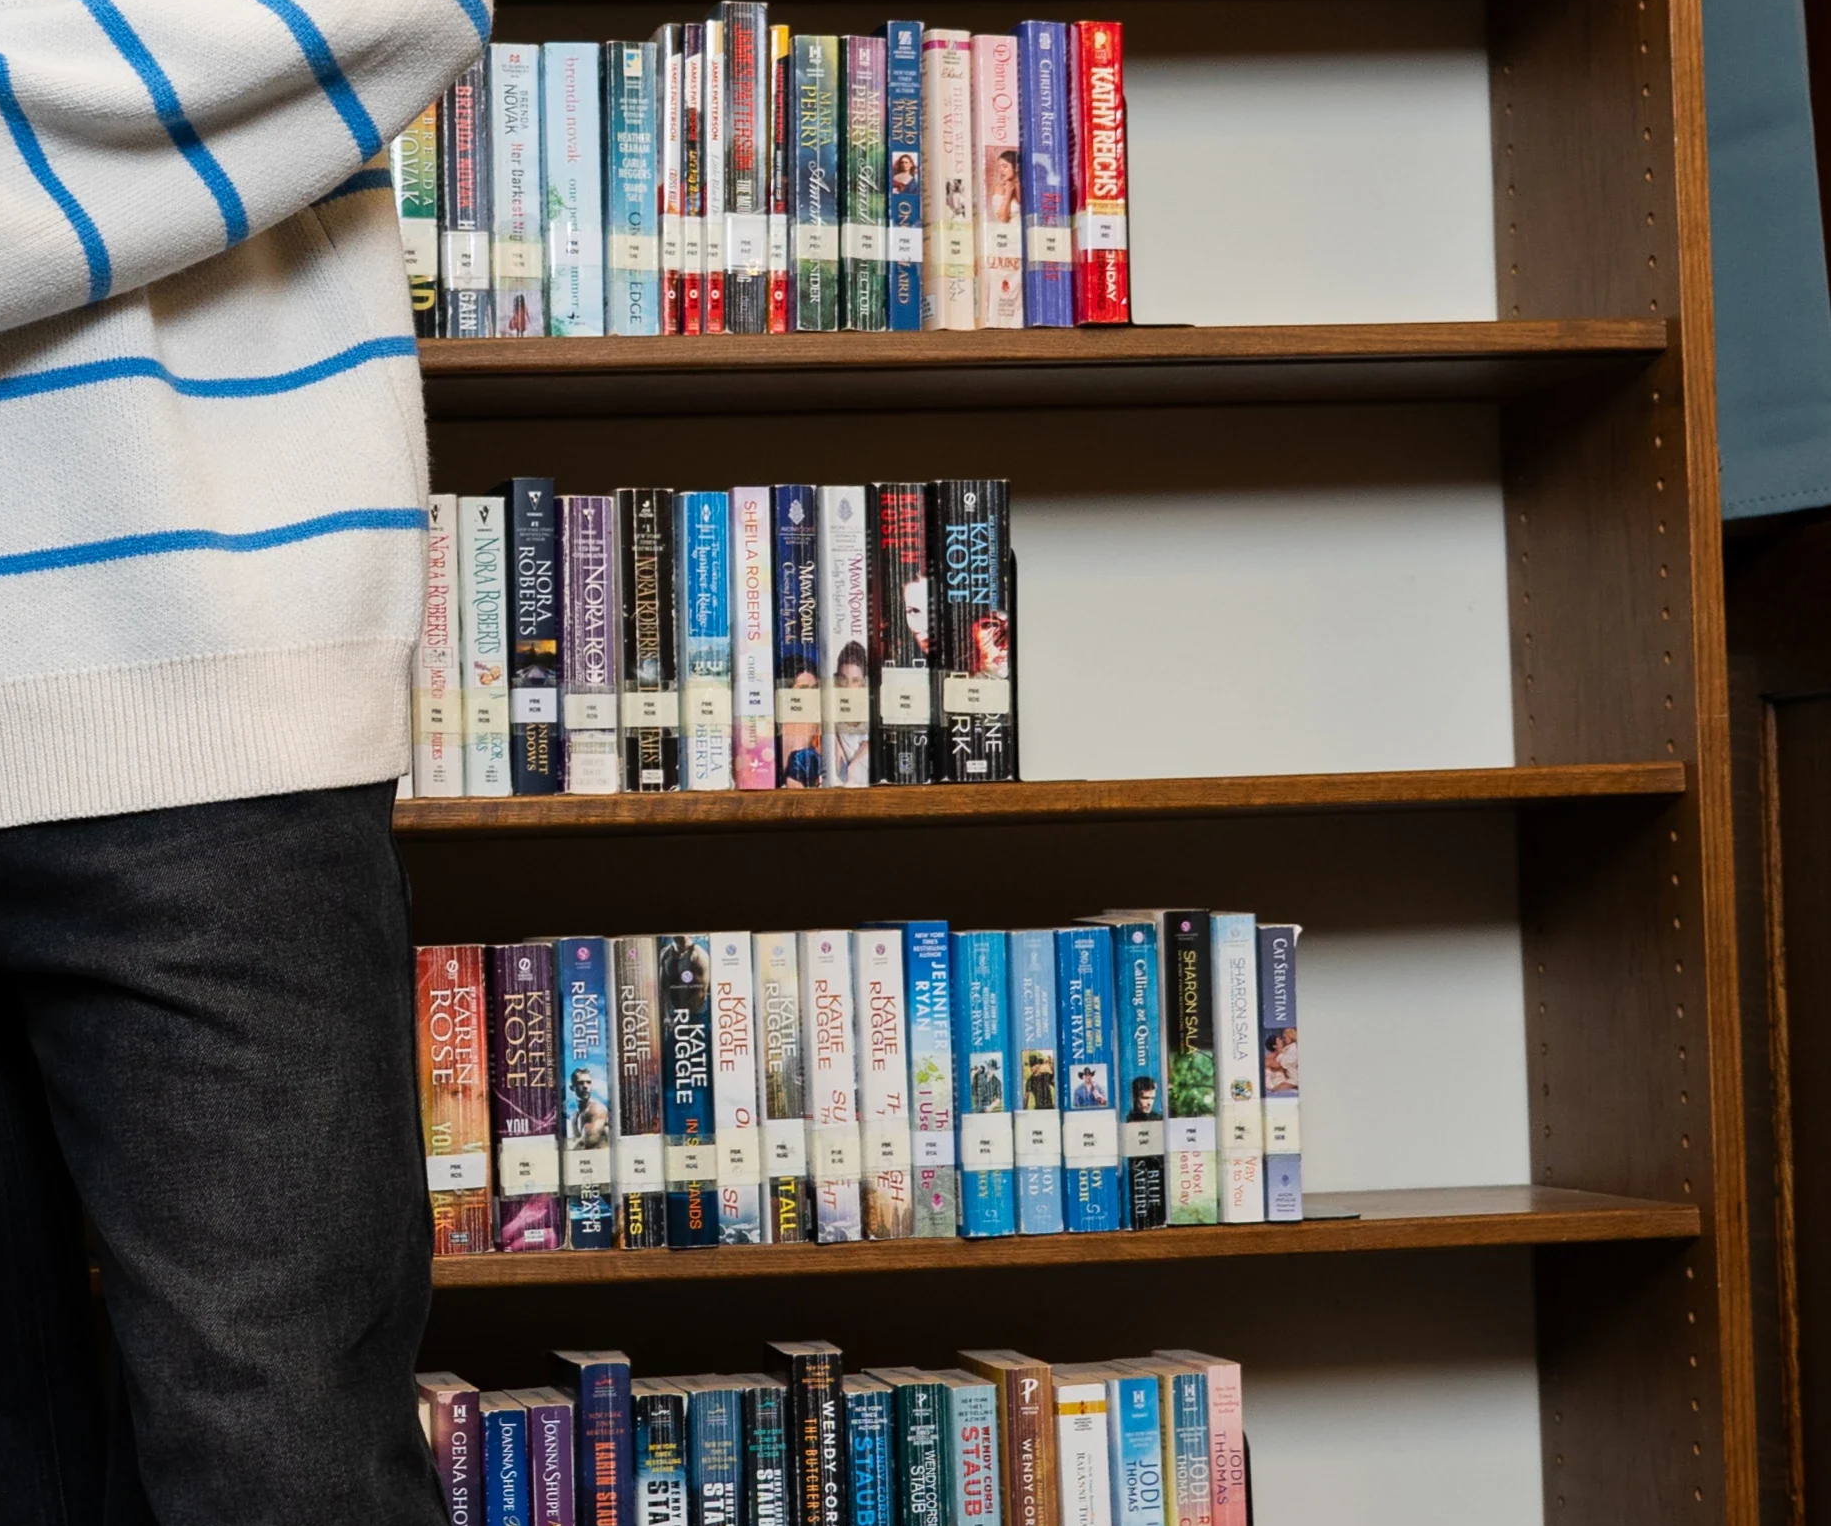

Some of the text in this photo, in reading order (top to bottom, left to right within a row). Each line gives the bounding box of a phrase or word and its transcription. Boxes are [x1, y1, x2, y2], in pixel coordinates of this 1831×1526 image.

[504, 84, 519, 135] NOVAK
[564, 57, 581, 163] brenda novak
[800, 85, 816, 151] PERRY
[819, 92, 831, 144] MARTA
[1092, 66, 1117, 195] KATHY REICHS
[473, 537, 500, 654] NORA ROBERTS
[518, 547, 535, 635] ROBERTS
[535, 560, 551, 621] NORA
[744, 501, 760, 641] SHEILA ROBERTS
[946, 524, 968, 604] ROSE
[971, 522, 989, 604] KAREN
[915, 981, 930, 1031] RYAN
[932, 961, 947, 1049] JENNIFER
[1183, 951, 1198, 1055] SHARON SALA
[1273, 938, 1288, 1021] CAT SEBASTIAN
[430, 989, 452, 1086] ROSE
[453, 986, 473, 1084] KAREN
[673, 1009, 691, 1104] RUGGLE
[689, 1024, 707, 1087] KATIE
[451, 1432, 466, 1483] GENA
[596, 1442, 615, 1486] KARIN
[671, 1480, 681, 1518] WENDY
